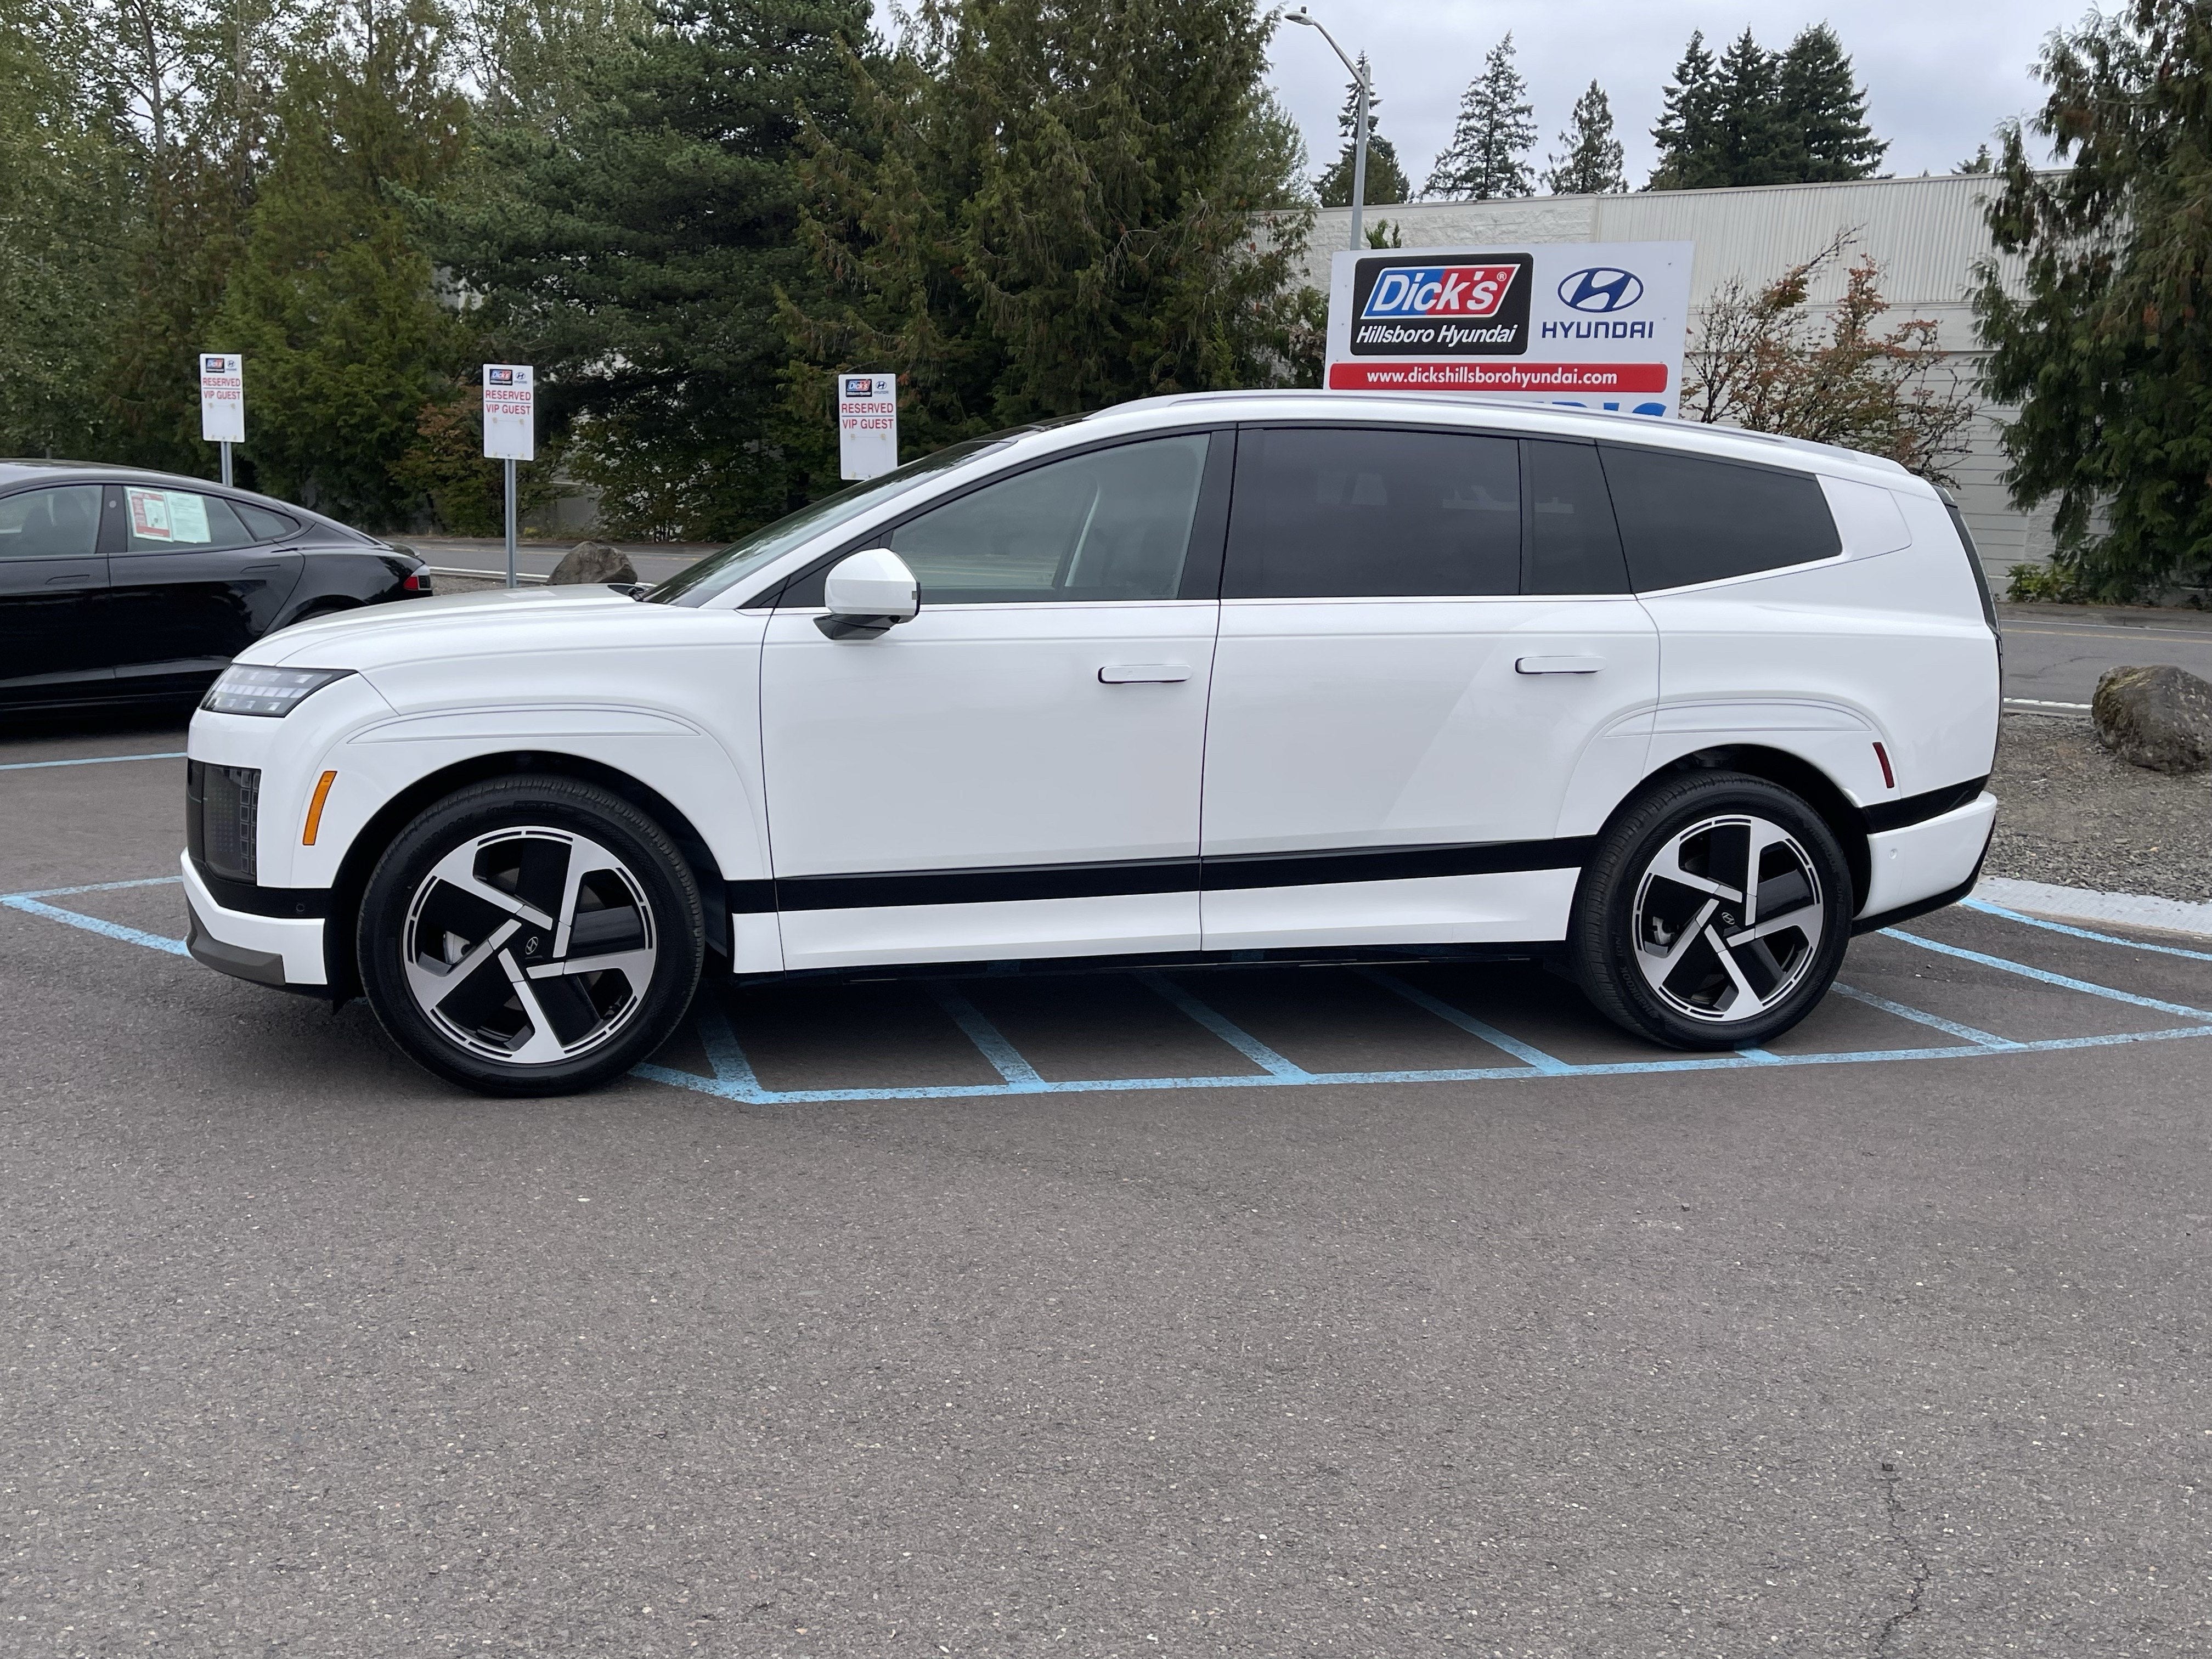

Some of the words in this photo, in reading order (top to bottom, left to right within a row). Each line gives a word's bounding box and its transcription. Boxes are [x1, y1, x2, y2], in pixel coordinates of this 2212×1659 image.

[1542, 321, 1654, 338] HYUNDAI
[1356, 325, 1435, 343] Hillsboro
[1437, 324, 1518, 348] Hyundai
[203, 377, 241, 387] RESERVED
[1367, 366, 1617, 388] www.dickshillsborohyundai.com
[204, 391, 215, 399] VIP
[217, 391, 241, 400] GUEST
[486, 390, 531, 400] RESERVED
[486, 404, 499, 413] VIP
[502, 404, 531, 415] GUEST
[842, 403, 894, 413] RESERVED
[842, 419, 857, 428] VIP
[861, 419, 894, 429] GUEST
